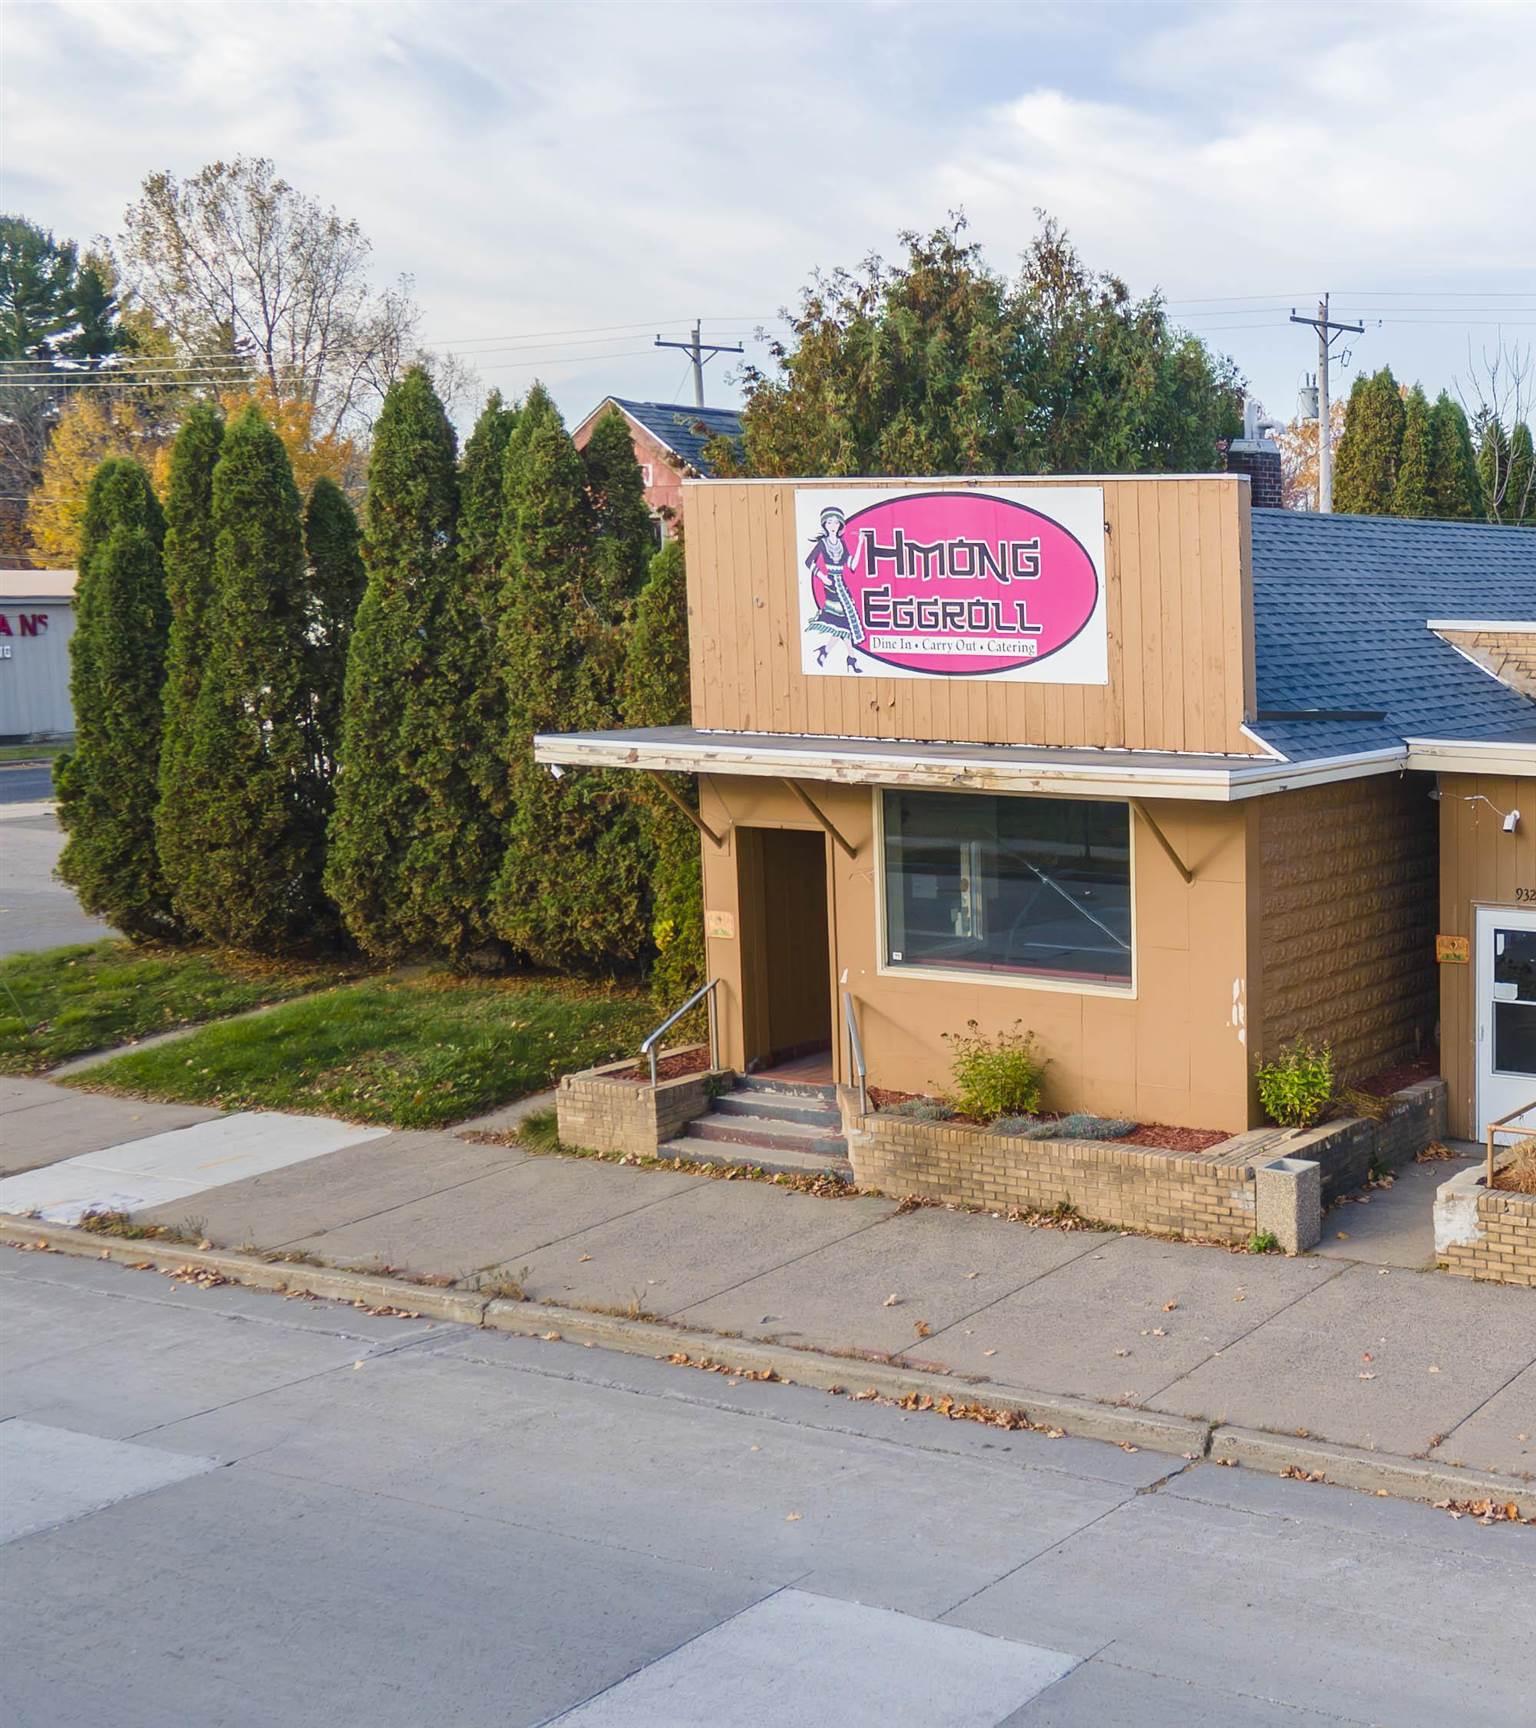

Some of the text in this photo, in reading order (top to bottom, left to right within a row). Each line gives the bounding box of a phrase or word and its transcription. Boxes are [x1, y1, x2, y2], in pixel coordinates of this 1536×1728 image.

[864, 586, 1042, 632] EGGROLL
[872, 636, 1035, 654] Dine In Carry Out Catering
[1516, 888, 1536, 901] 932
